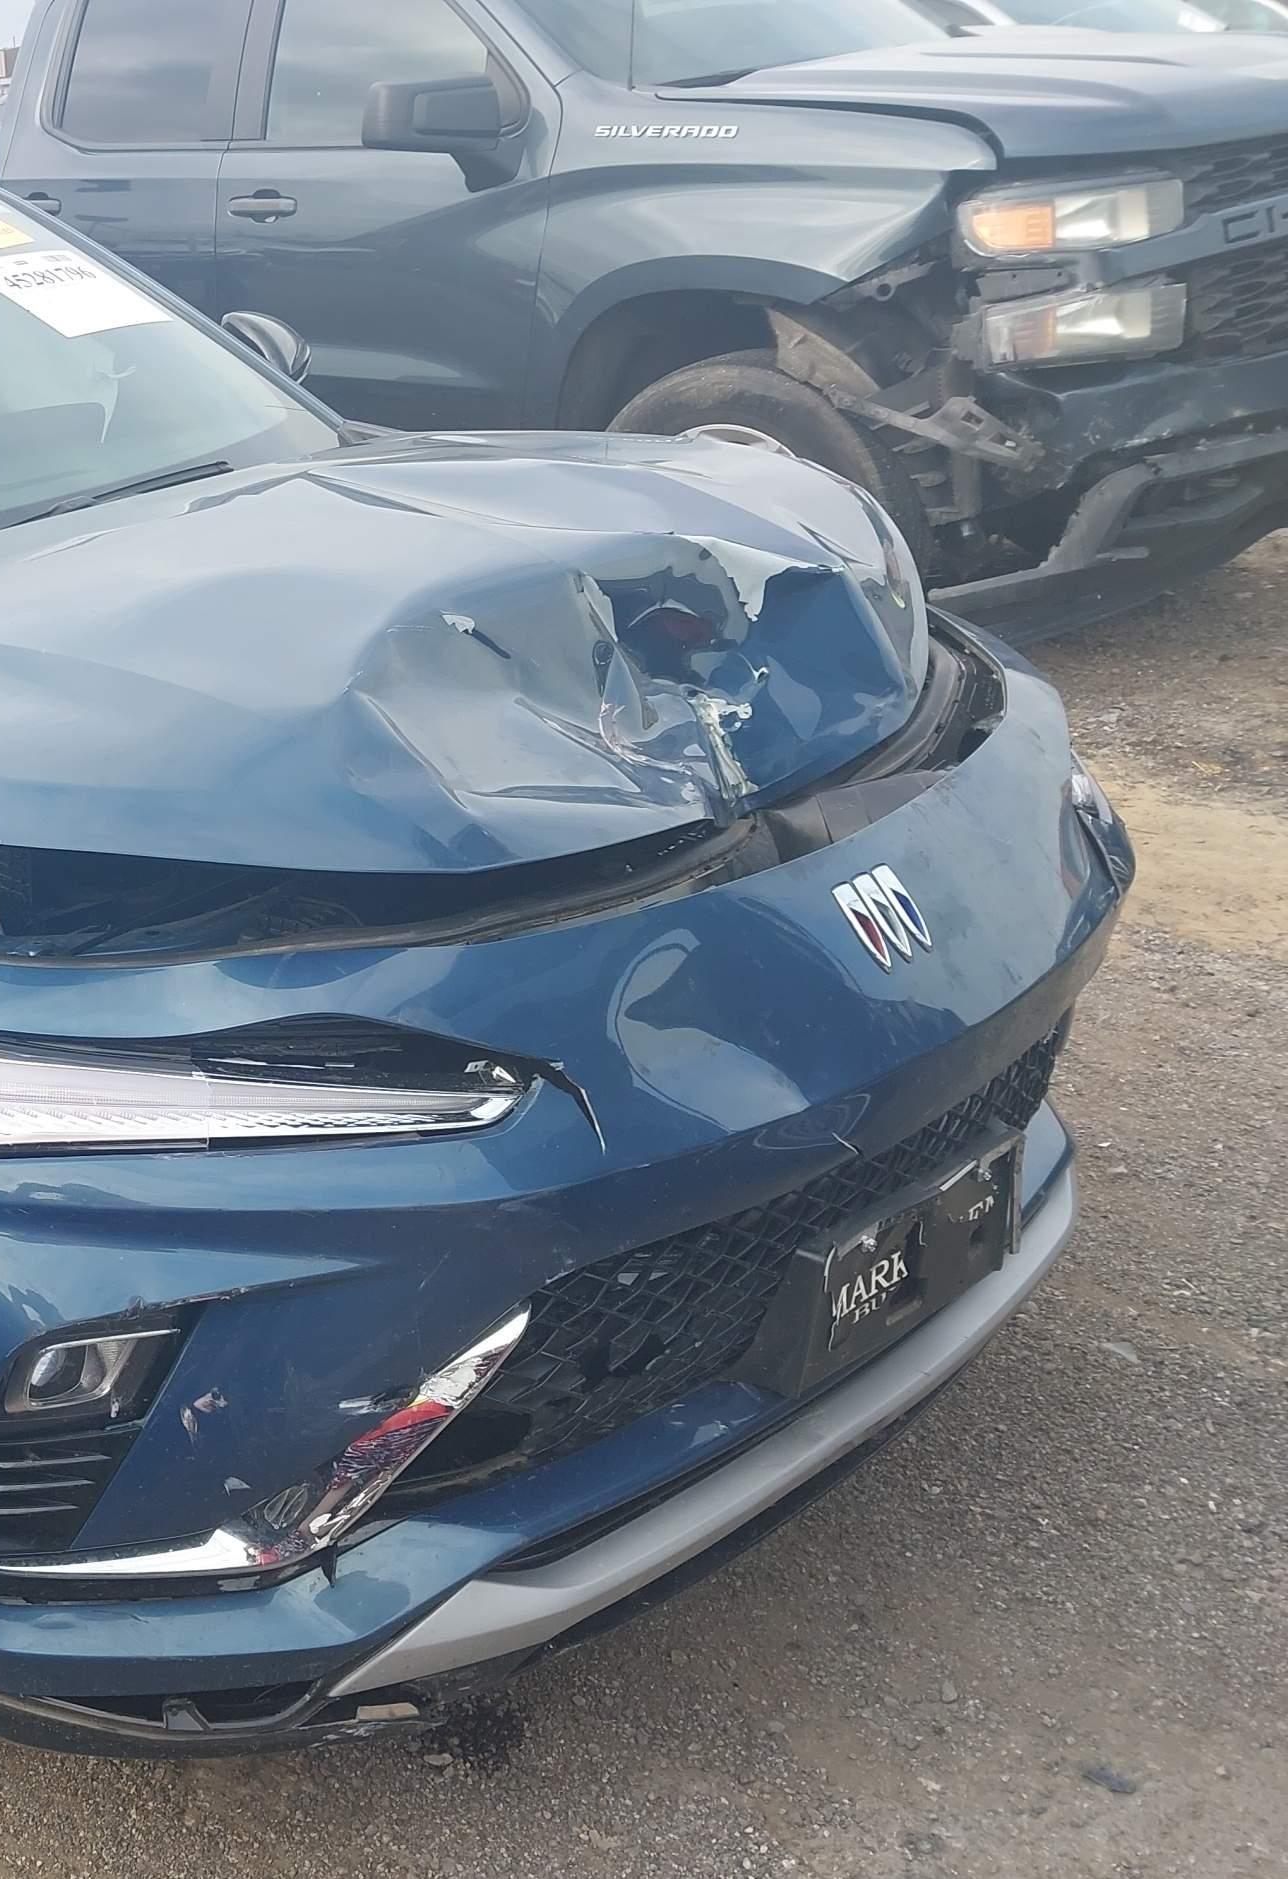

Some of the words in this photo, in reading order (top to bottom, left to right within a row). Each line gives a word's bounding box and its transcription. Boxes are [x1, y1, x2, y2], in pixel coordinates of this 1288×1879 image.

[594, 125, 739, 138] SILVERADO
[3, 266, 97, 289] 45281796
[832, 1250, 909, 1318] MARK
